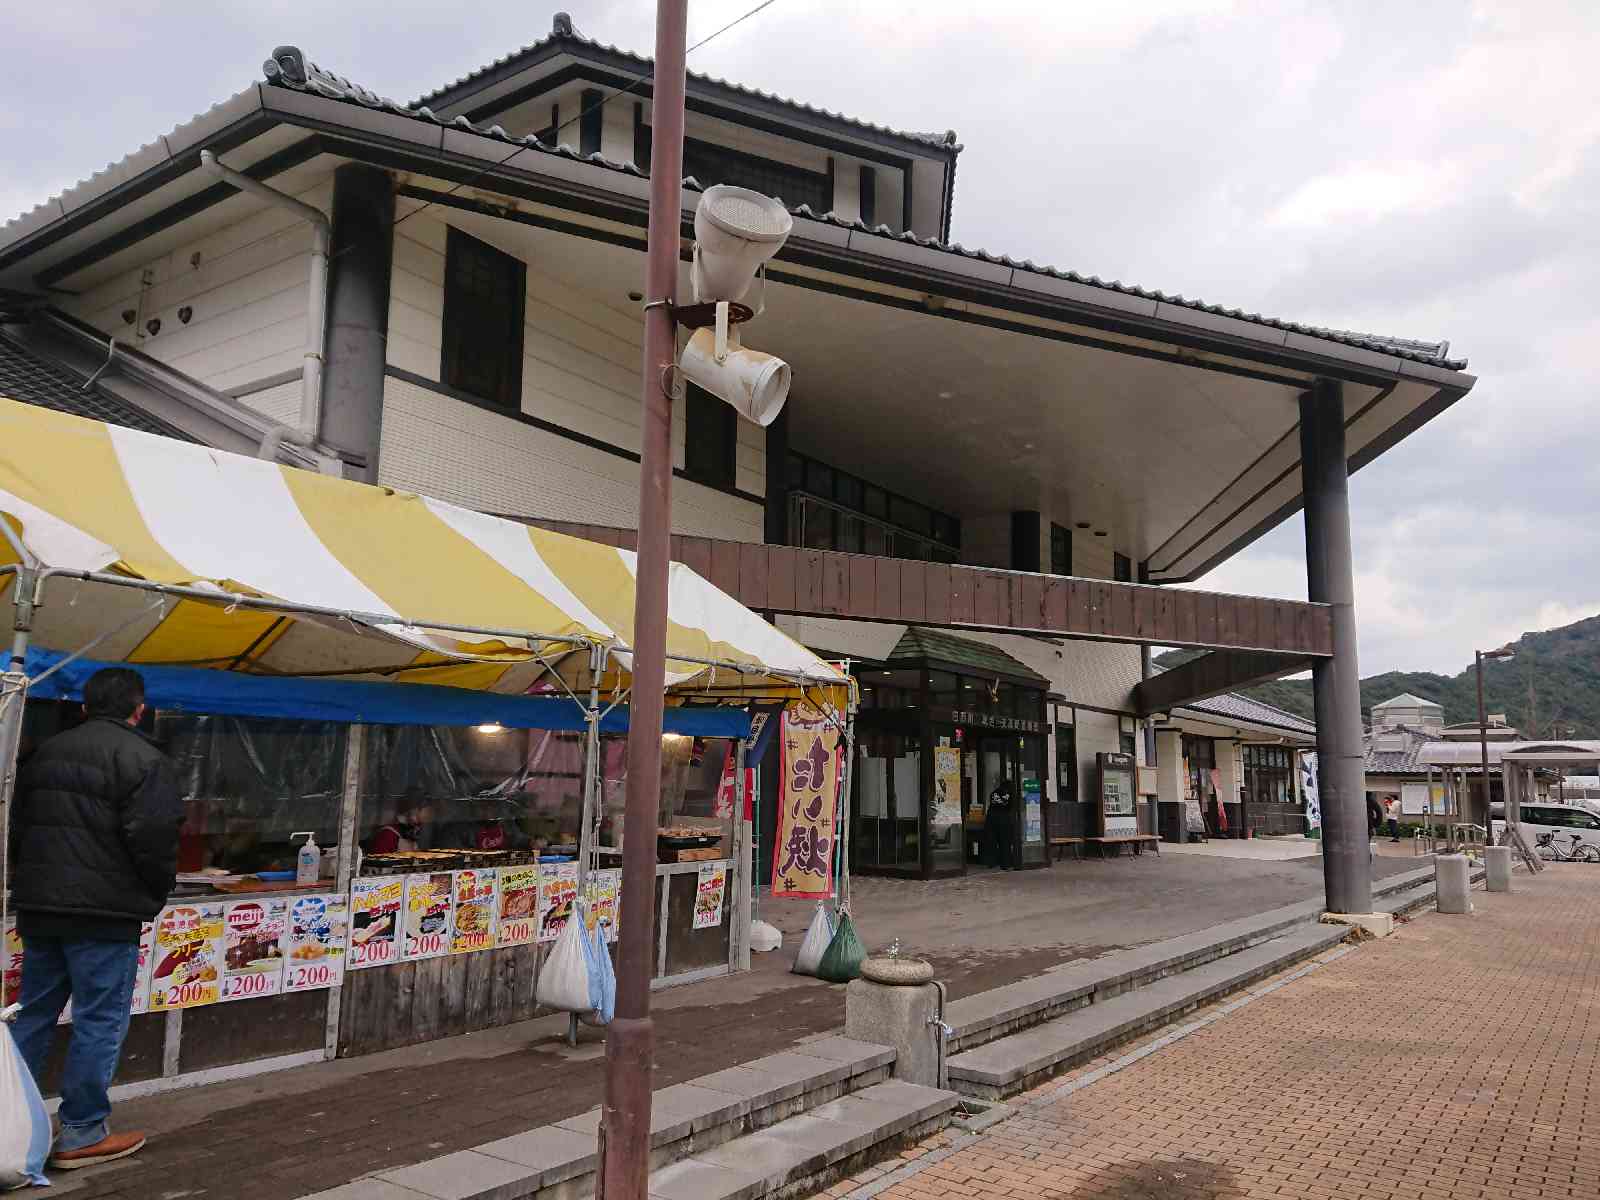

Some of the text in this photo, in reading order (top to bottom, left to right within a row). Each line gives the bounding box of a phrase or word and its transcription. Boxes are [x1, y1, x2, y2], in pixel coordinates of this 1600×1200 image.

[229, 907, 263, 925] meiji
[356, 939, 400, 963] 200円
[232, 972, 274, 994] 200円
[296, 965, 337, 986] 200円
[167, 982, 212, 1005] 200円
